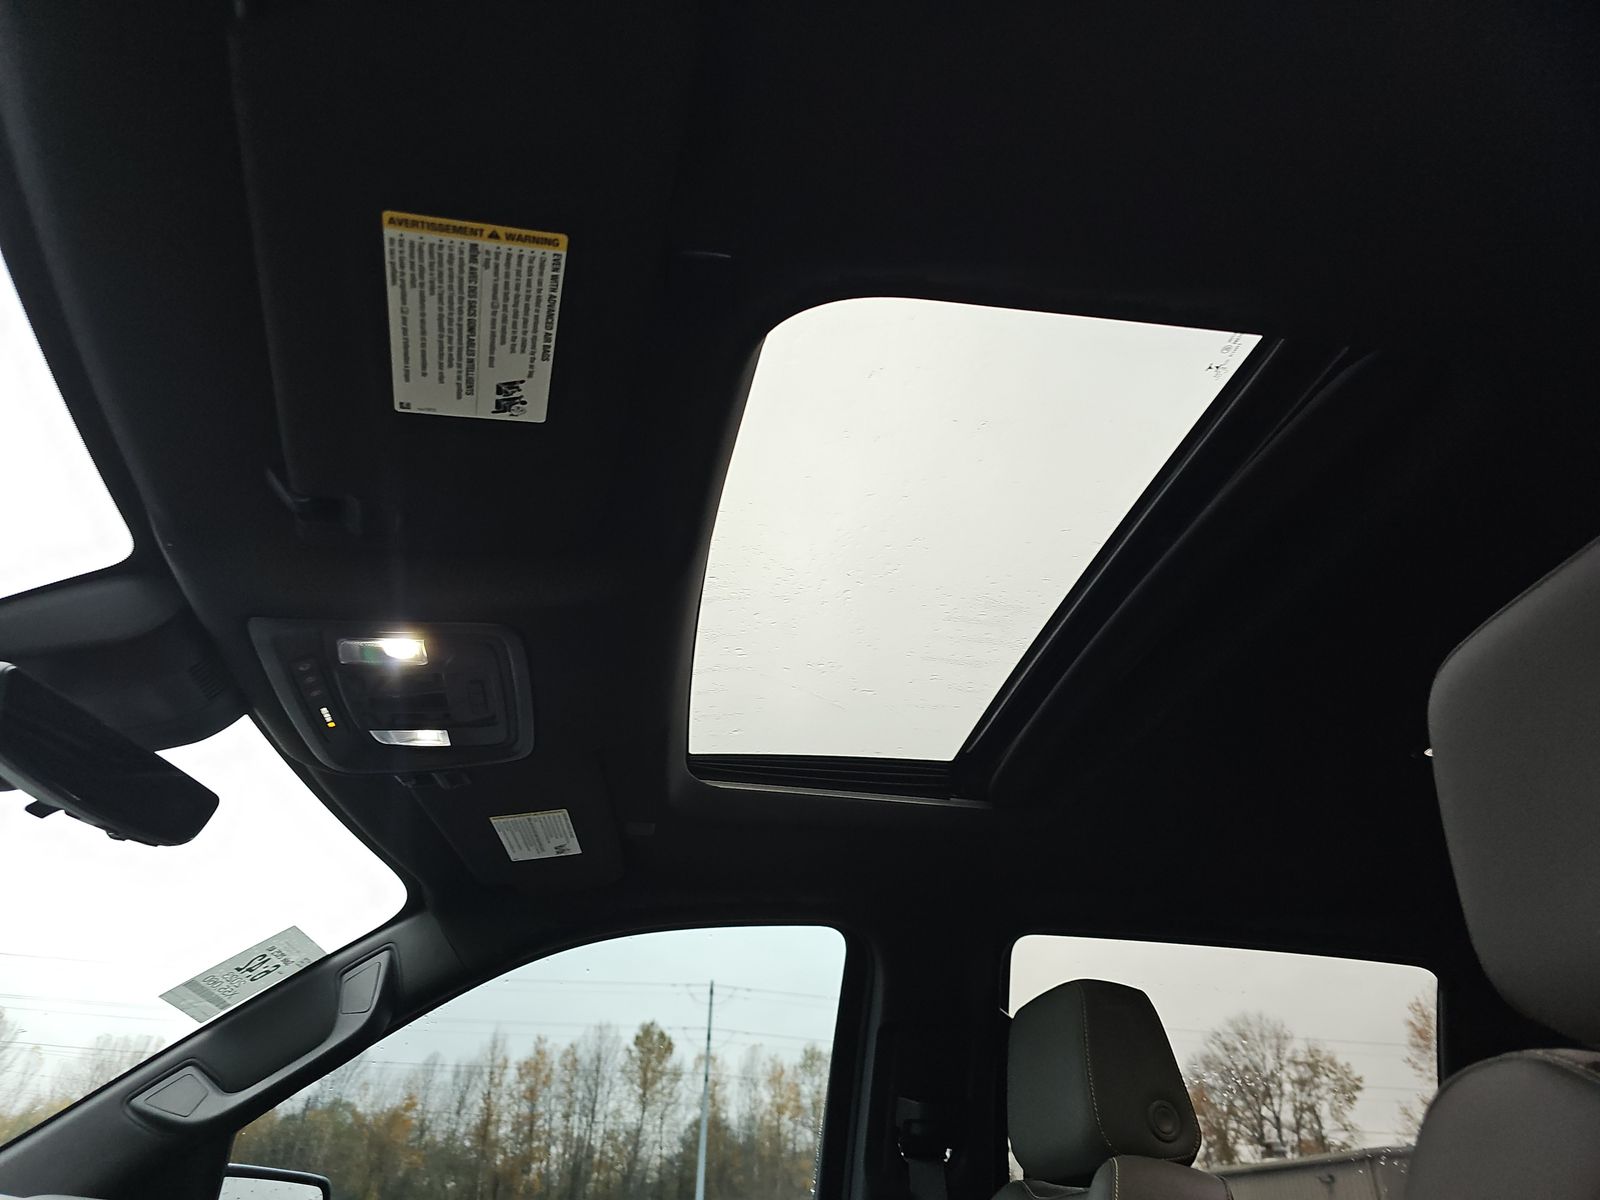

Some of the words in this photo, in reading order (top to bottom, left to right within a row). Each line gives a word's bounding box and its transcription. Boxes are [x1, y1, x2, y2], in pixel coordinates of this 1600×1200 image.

[388, 216, 484, 237] AVERTISSEMENT
[505, 232, 560, 247] WARNING
[551, 253, 562, 272] EVEN
[549, 273, 559, 293] WITH
[544, 294, 557, 330] ADVANCED
[543, 332, 552, 343] AIR
